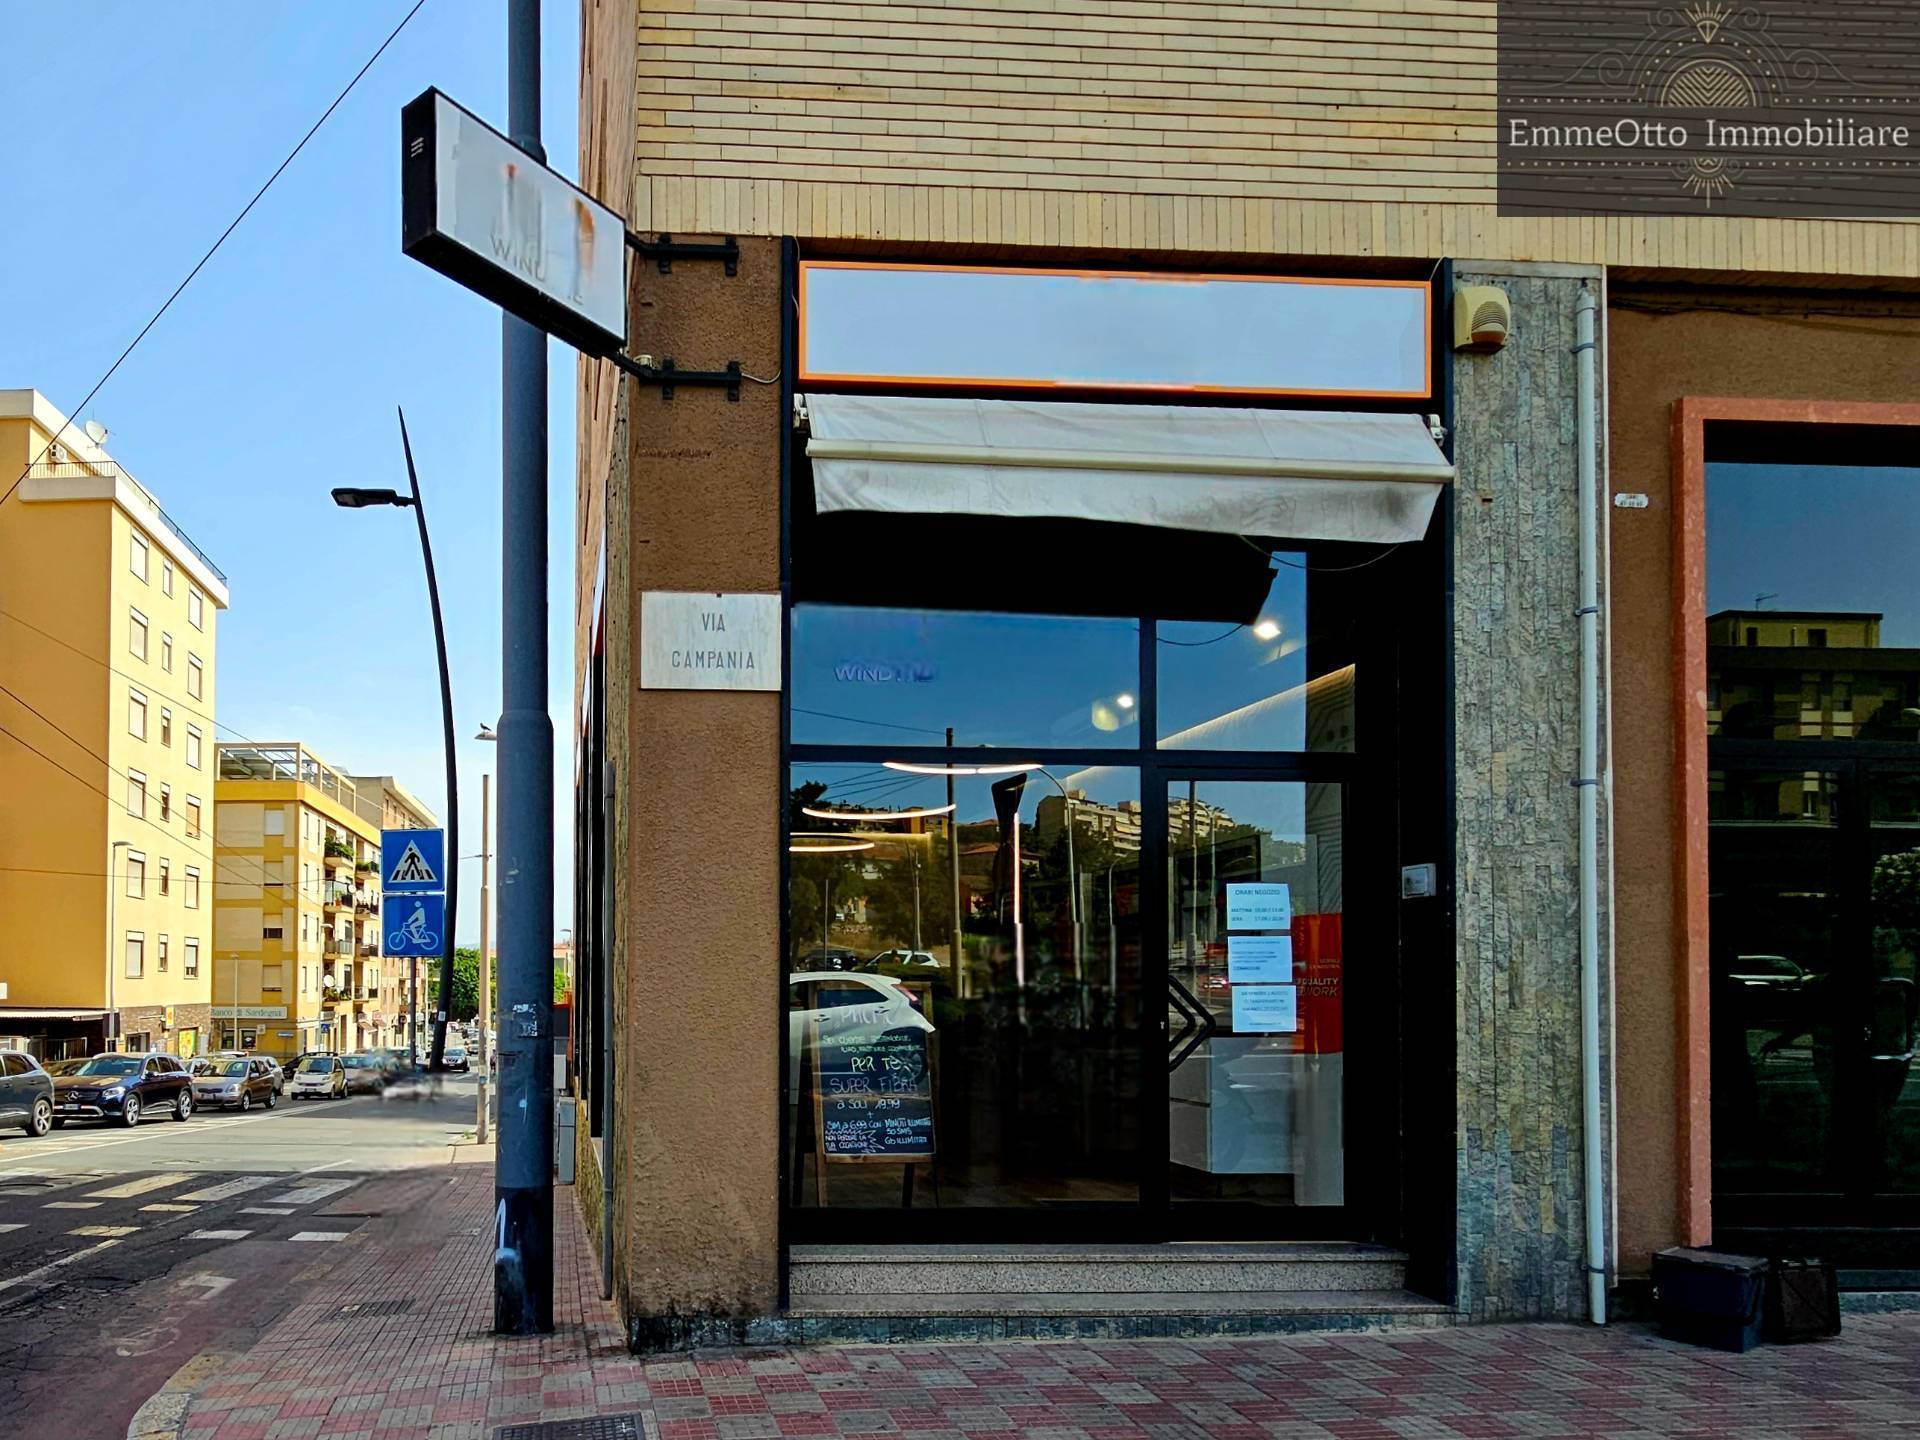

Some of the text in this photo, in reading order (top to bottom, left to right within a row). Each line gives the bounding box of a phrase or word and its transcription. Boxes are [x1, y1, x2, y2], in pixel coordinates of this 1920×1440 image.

[701, 612, 726, 632] VIA
[671, 650, 755, 670] CAMPANIA
[245, 1008, 282, 1018] Sardegna
